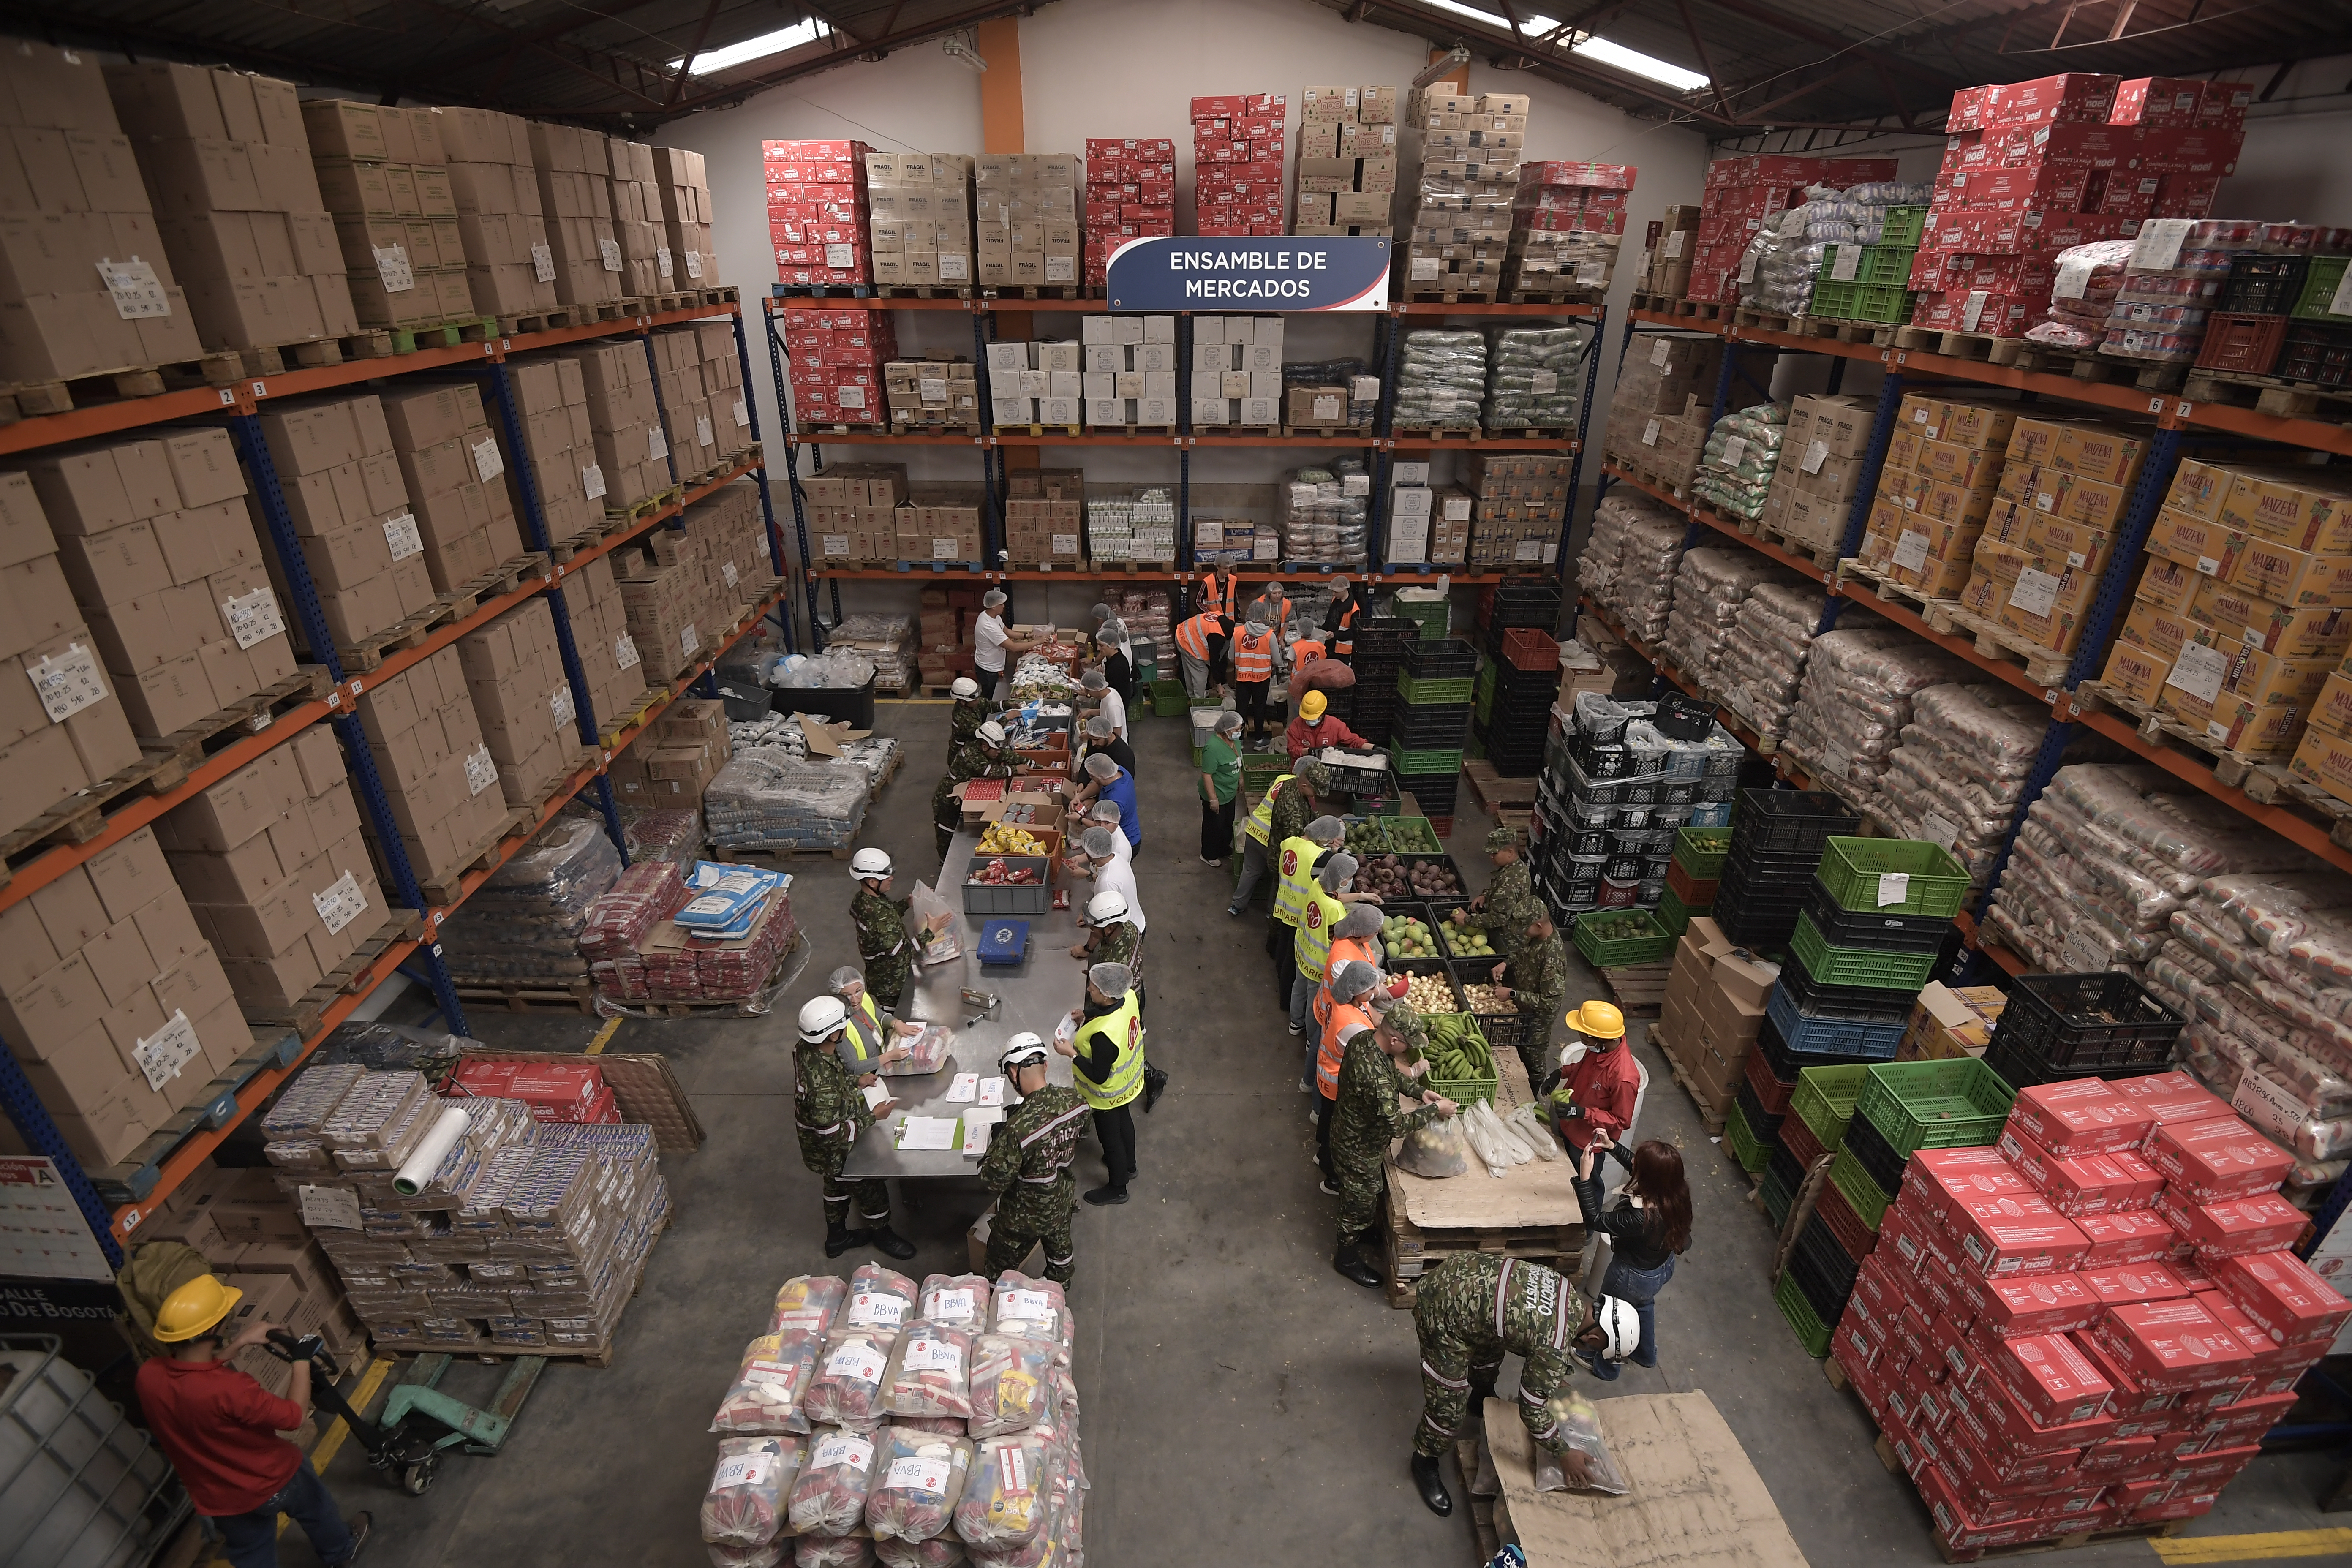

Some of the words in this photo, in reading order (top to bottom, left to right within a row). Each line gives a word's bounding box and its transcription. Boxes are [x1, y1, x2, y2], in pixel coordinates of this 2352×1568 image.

[1320, 98, 1345, 110] noel
[1964, 109, 1978, 117] noel
[2026, 110, 2042, 121] noel
[1358, 135, 1382, 146] noel
[1965, 148, 1986, 163] noel
[2010, 145, 2027, 158] noel
[2095, 157, 2116, 167] noel
[1936, 192, 1949, 202] noel
[2057, 190, 2076, 199] noel
[1998, 198, 2014, 208] noel
[1942, 231, 1962, 244] noel
[2052, 232, 2082, 246] noel
[1171, 252, 1290, 270] ENSAMBLE
[1298, 252, 1327, 270] DE
[1976, 272, 1996, 285] noel
[2024, 275, 2046, 285] noel
[1186, 280, 1310, 297] MERCADOS
[1932, 308, 1951, 319] noel
[256, 385, 263, 394] 3
[224, 392, 231, 402] 2
[2153, 400, 2159, 410] 6
[2180, 405, 2188, 414] 7
[1818, 416, 1833, 425] FRÁGIL
[1838, 422, 1853, 431] FRÁGIL
[2020, 429, 2047, 445] MAIZENA
[2084, 442, 2112, 458] MAIZENA
[2182, 471, 2213, 493] MAIZENA
[2080, 490, 2109, 508] MAIZENA
[1794, 502, 1809, 513] FRÁGIL
[2261, 495, 2298, 518] MAIZENA
[2049, 526, 2073, 544] MAIZENA
[2175, 525, 2205, 546] MAIZENA
[2251, 551, 2289, 577] MAIZENA
[2155, 618, 2184, 642] MAIZENA
[242, 634, 252, 642] 480
[2181, 653, 2203, 667] AB6080
[2118, 656, 2152, 681] MAIZENA
[81, 677, 90, 686] 12
[2172, 675, 2184, 684] 500
[354, 683, 361, 692] 11
[2202, 688, 2211, 696] 28
[54, 703, 68, 715] 480
[90, 687, 100, 696] 28
[330, 696, 338, 705] 10
[2071, 705, 2079, 713] 15
[332, 919, 341, 929] 480
[355, 902, 361, 910] 28
[435, 914, 441, 923] 19
[2066, 930, 2087, 955] AB2896
[434, 946, 441, 955] 26
[1960, 952, 1967, 960] 30
[2062, 949, 2077, 966] 1800
[155, 1070, 166, 1083] 480
[185, 1048, 193, 1056] 28
[2241, 1078, 2271, 1103] AB2896
[2287, 1109, 2302, 1122] 500
[2234, 1097, 2254, 1117] 1800
[2273, 1113, 2284, 1125] 25
[2023, 1116, 2044, 1135] noel
[2106, 1141, 2130, 1154] noel
[2022, 1162, 2047, 1182] noel
[2161, 1155, 2184, 1176] noel
[39, 1170, 54, 1182] A
[2246, 1183, 2274, 1195] noel
[126, 1213, 136, 1227] 17
[1927, 1241, 1948, 1265] noel
[2127, 1252, 2155, 1264] noel
[2025, 1259, 2054, 1269] noel
[944, 1297, 967, 1309] BBVA
[1024, 1297, 1044, 1307] BBVA
[9, 1302, 41, 1317] DE
[40, 1301, 116, 1318] BOGOTÁ
[874, 1303, 899, 1317] BBVA
[2240, 1303, 2273, 1330] noel
[2049, 1320, 2079, 1333] noel
[835, 1356, 860, 1367] BBVA
[931, 1349, 956, 1362] BBVA
[822, 1446, 846, 1458] BBVA
[719, 1462, 745, 1480] BBVA
[893, 1463, 920, 1477] BBVA
